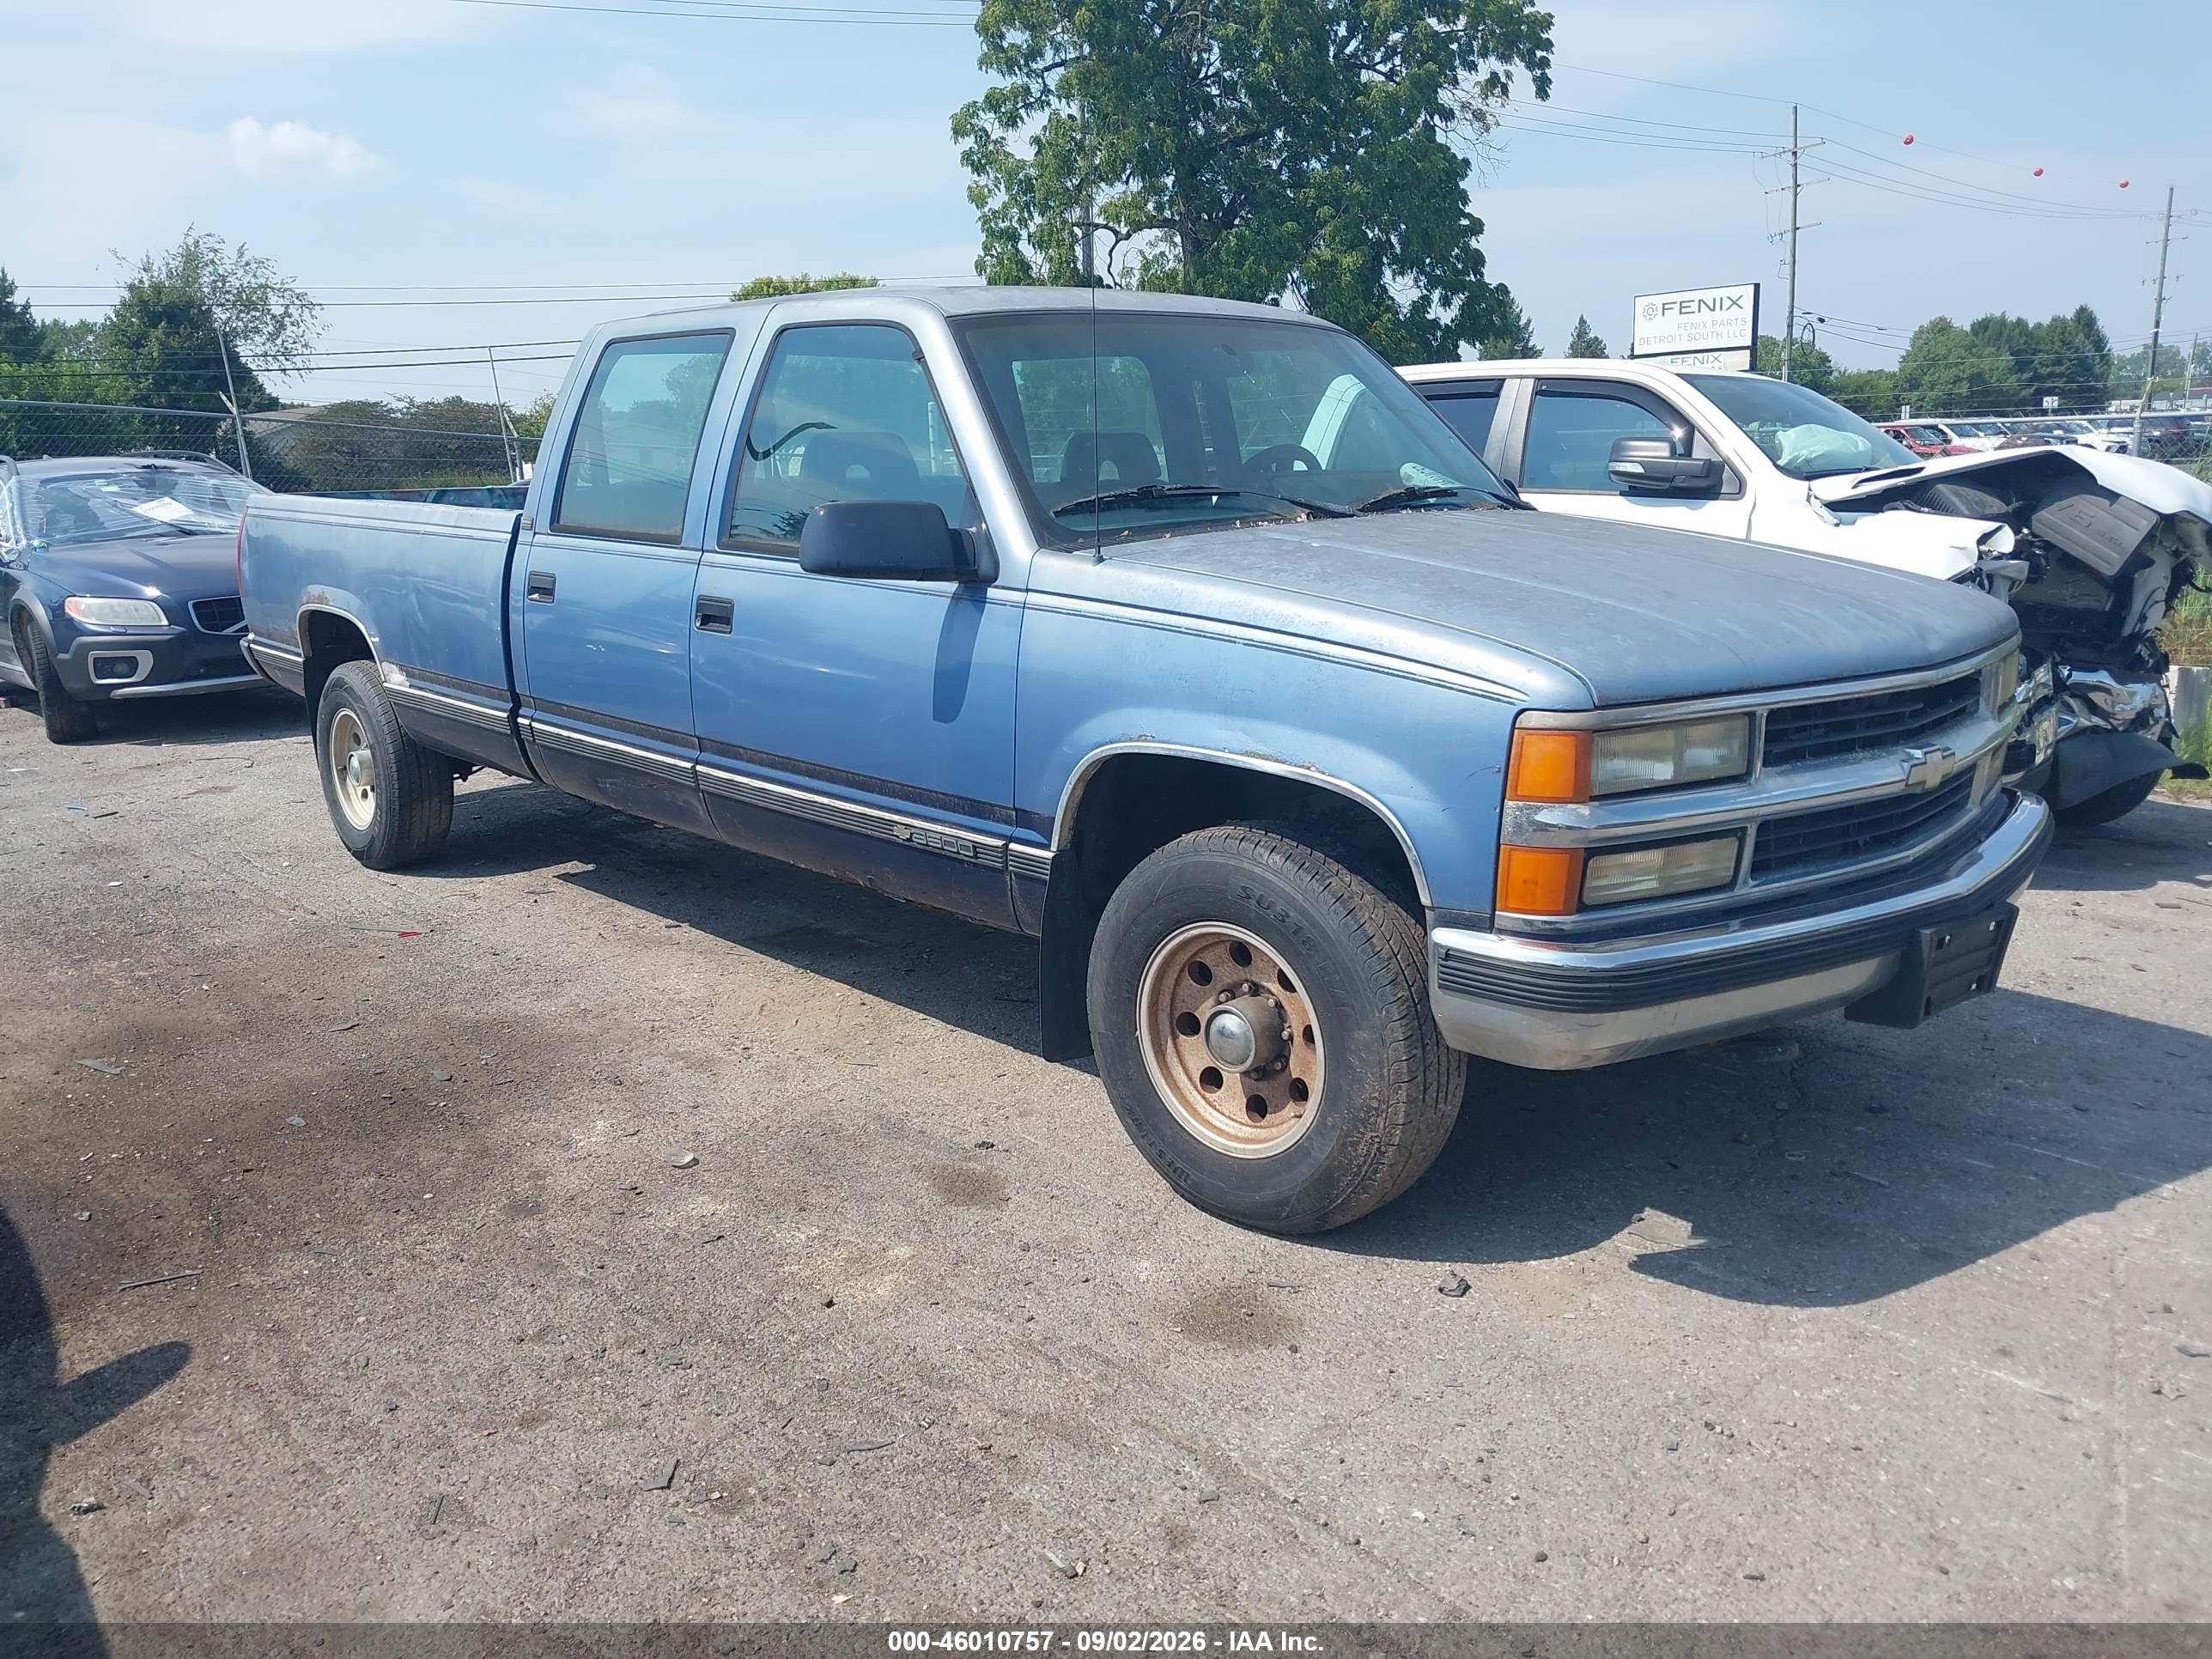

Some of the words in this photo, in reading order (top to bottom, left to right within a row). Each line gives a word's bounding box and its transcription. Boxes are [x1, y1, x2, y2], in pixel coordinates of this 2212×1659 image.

[1662, 295, 1744, 317] FENIX
[1677, 321, 1707, 331] FENIX
[1711, 318, 1747, 328] PARTS
[1639, 333, 1683, 346] DETROIT
[1686, 330, 1723, 343] SOUTH
[1727, 328, 1747, 338] LLC
[1670, 354, 1723, 366] FENIX
[1236, 884, 1318, 953] SU318
